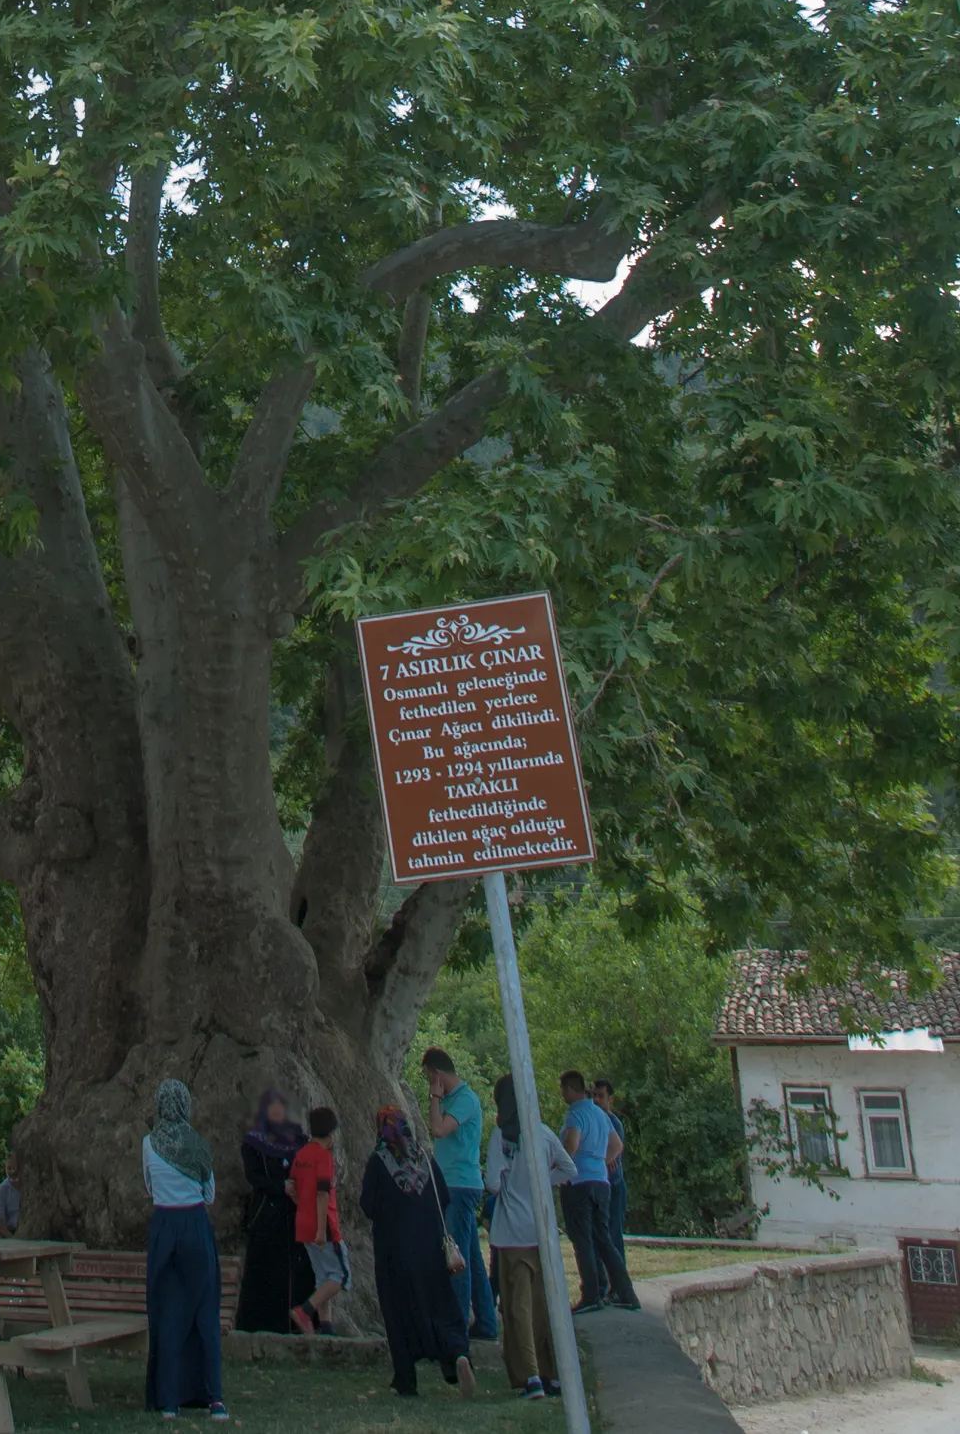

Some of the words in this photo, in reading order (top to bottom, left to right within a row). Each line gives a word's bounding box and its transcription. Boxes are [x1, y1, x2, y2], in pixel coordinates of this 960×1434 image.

[379, 664, 390, 681] 7
[395, 653, 476, 679] ASIRLIK
[479, 644, 545, 670] ÇINAR
[383, 683, 448, 702] Osmanlı
[456, 668, 547, 696] geleneğinde
[399, 700, 477, 721] fethedilen
[484, 692, 538, 713] yerlere
[388, 727, 432, 745] Çınar
[440, 720, 483, 739] Ağacı
[491, 709, 560, 730] dikilirdi.
[422, 745, 445, 760] Bu
[453, 735, 527, 758] ağacında;
[394, 768, 432, 784] 1293
[446, 762, 484, 778] 1294
[486, 752, 564, 774] yıllarında
[444, 777, 518, 799] TARAKLI
[428, 797, 547, 823] fethedildiğinde
[412, 827, 468, 847] dikilen
[471, 823, 507, 843] ağaç
[510, 817, 566, 839] olduğu
[408, 849, 465, 870] tahmin
[473, 839, 578, 861] edilmektedir.
